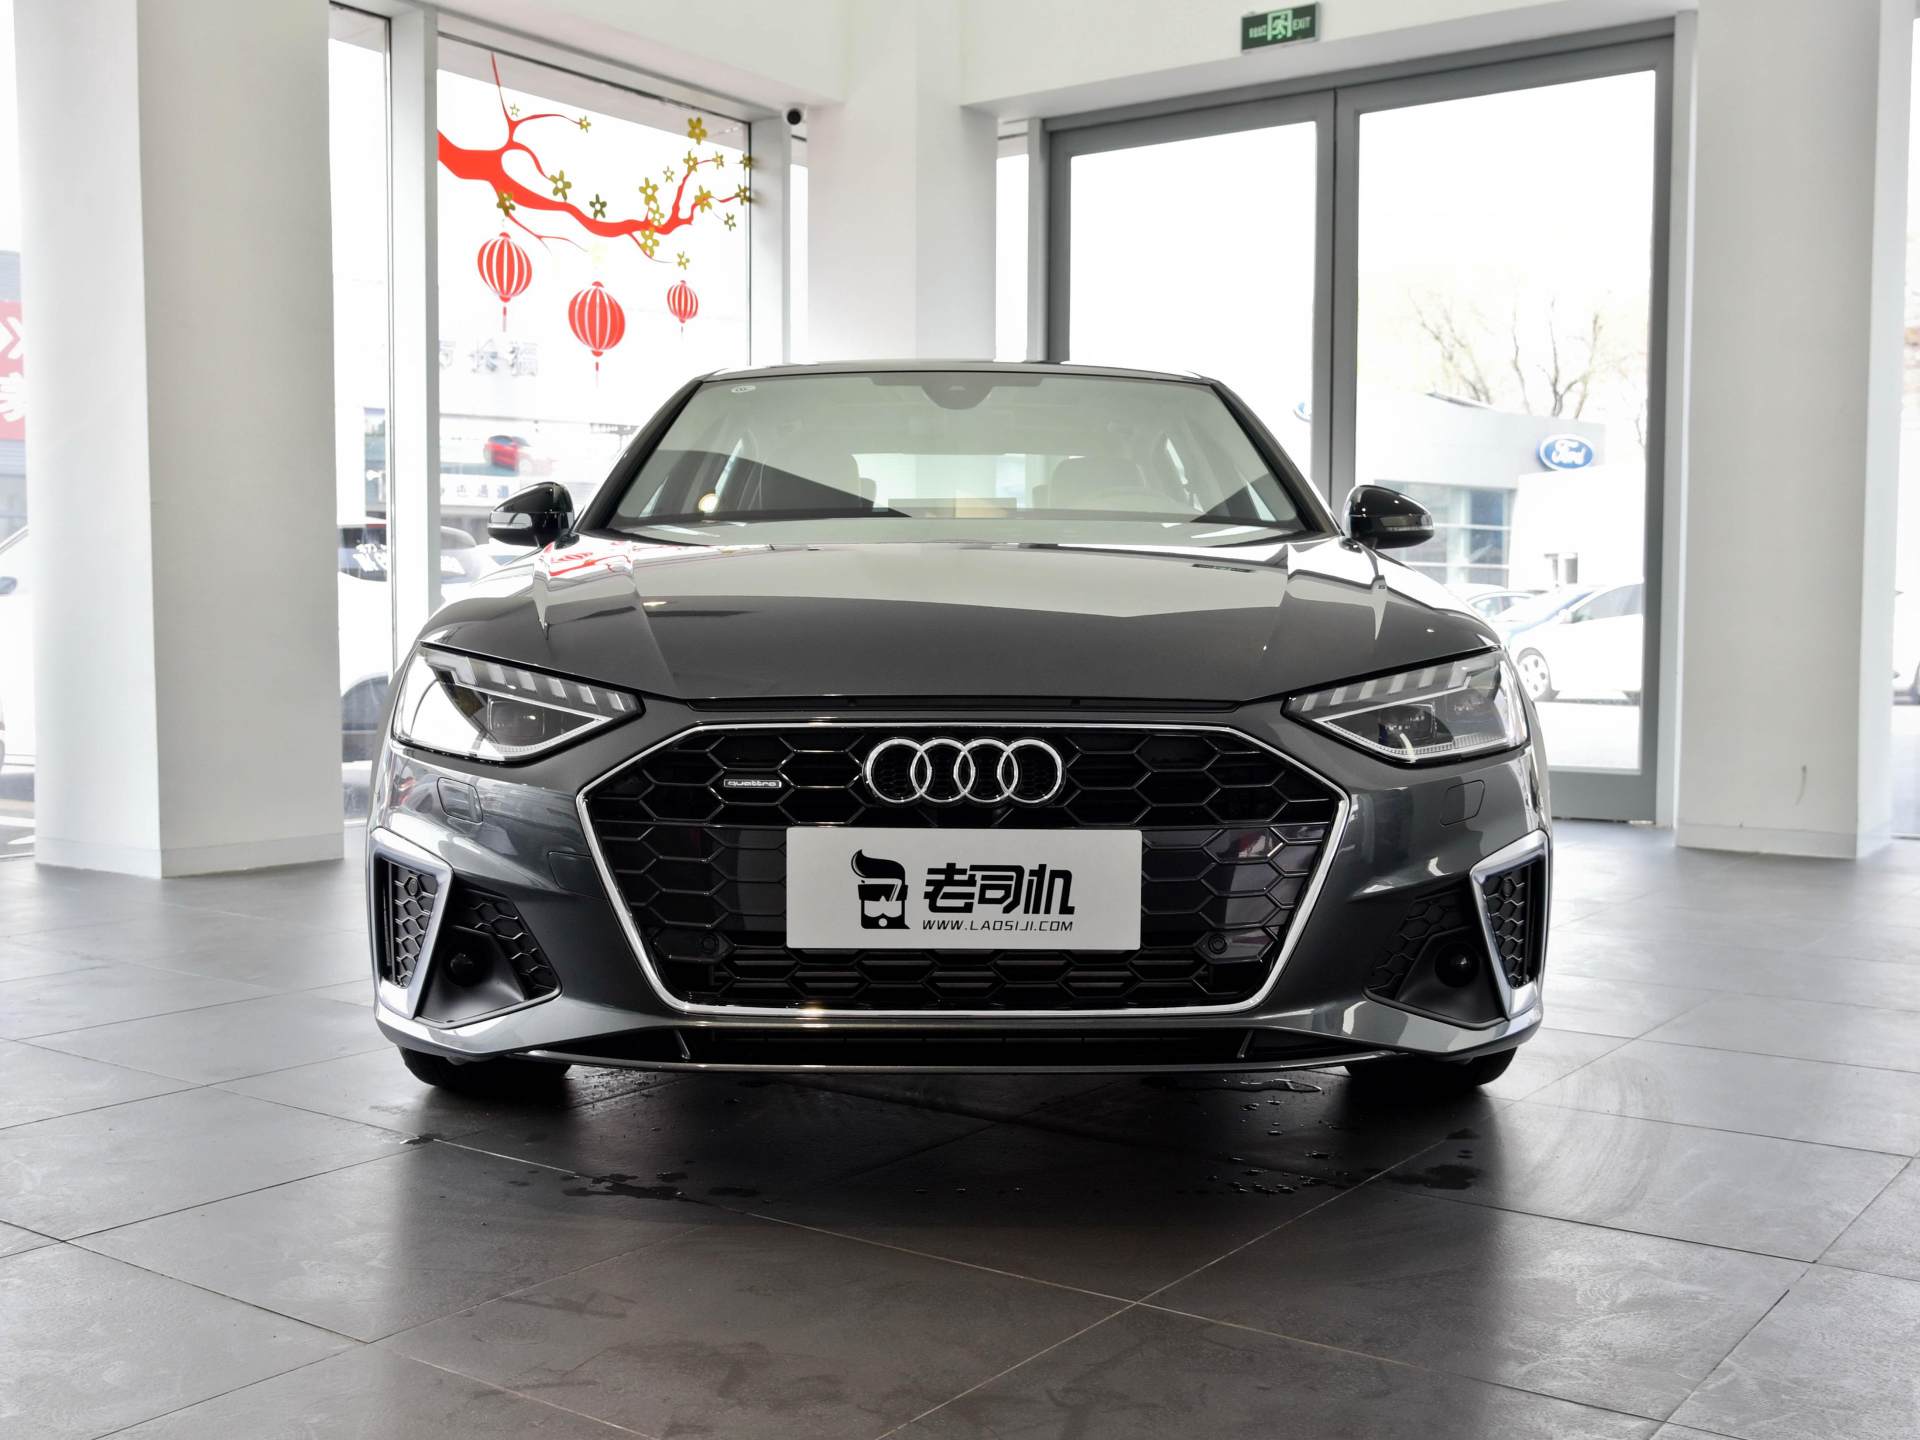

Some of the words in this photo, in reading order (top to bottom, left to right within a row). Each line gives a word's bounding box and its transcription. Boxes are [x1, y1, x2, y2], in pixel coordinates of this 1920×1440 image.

[1292, 16, 1312, 31] EXIT
[1552, 439, 1586, 465] Ford
[727, 780, 777, 788] quattro
[923, 862, 1076, 915] 老司机
[922, 919, 1074, 932] WWW.LAOSIJI.COM
